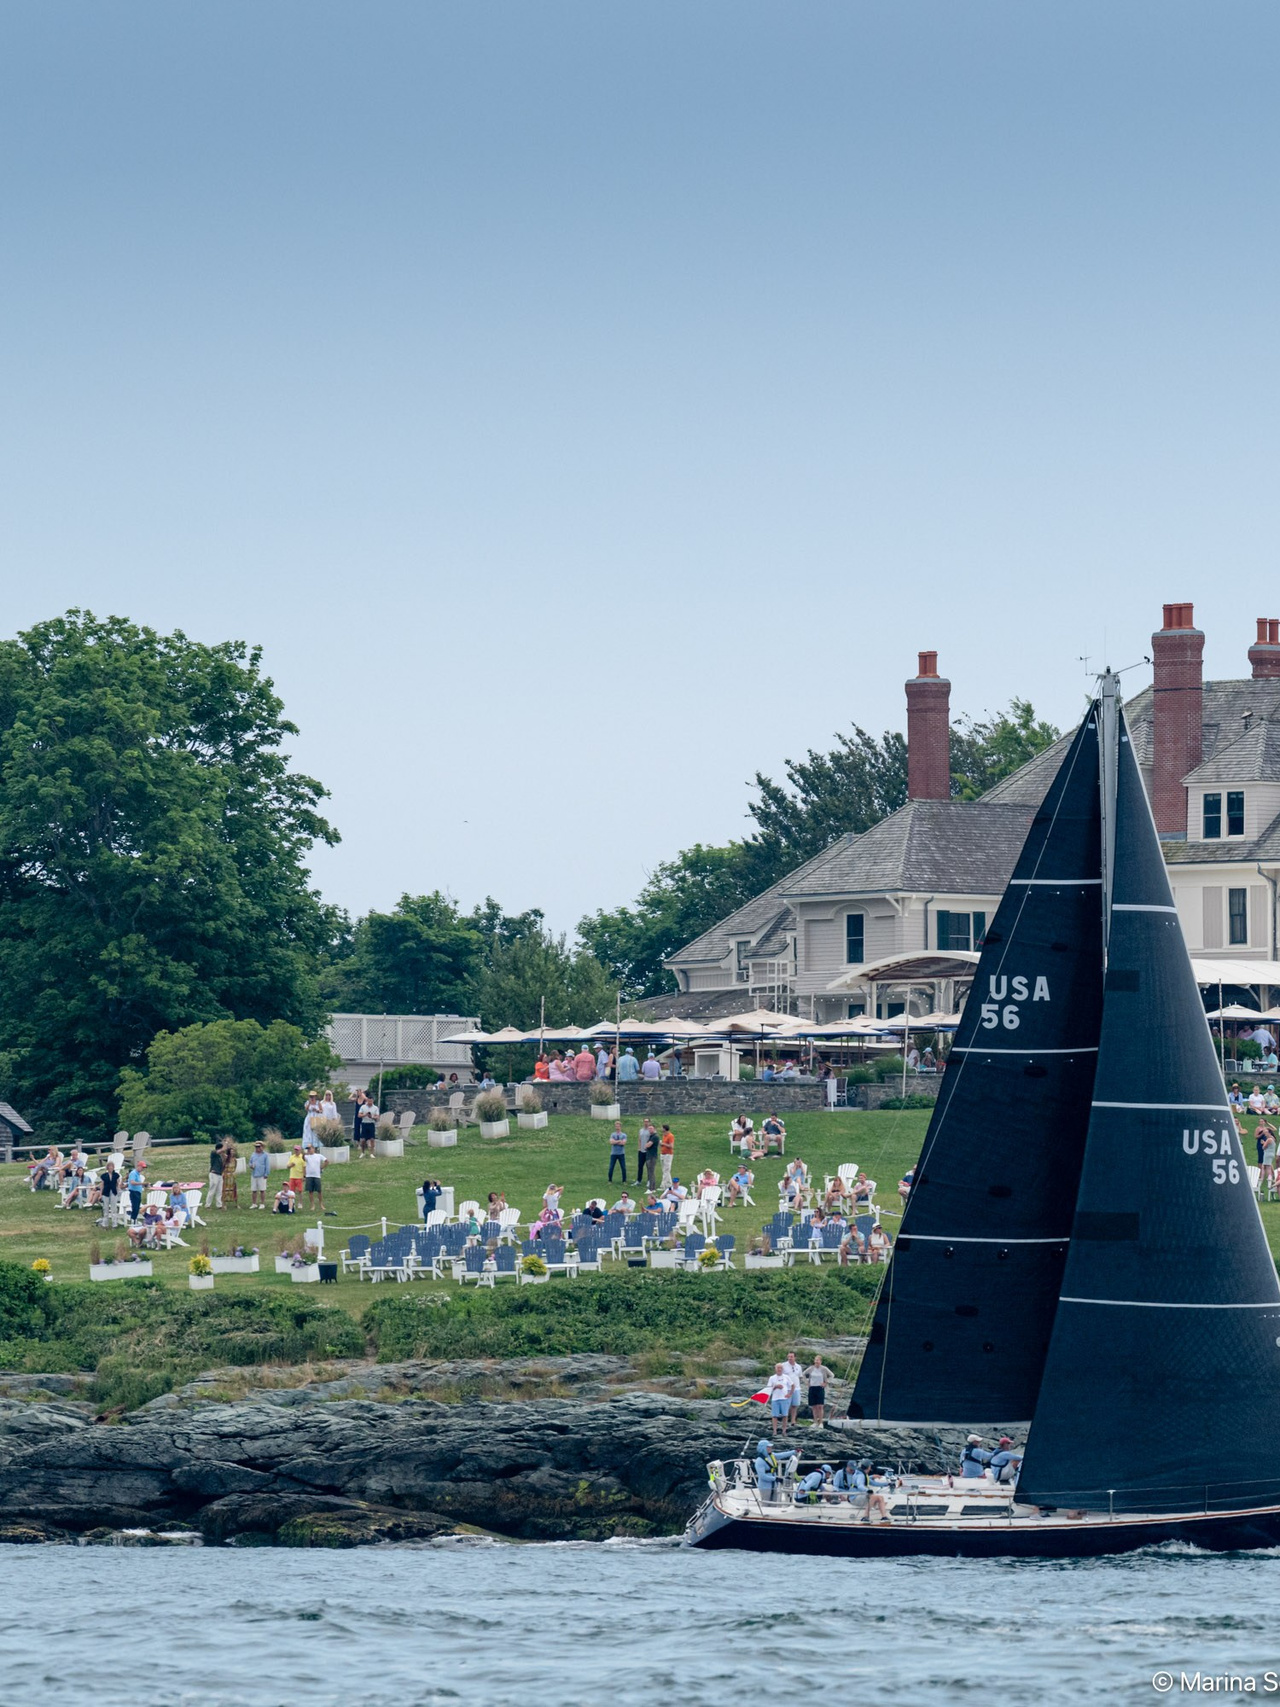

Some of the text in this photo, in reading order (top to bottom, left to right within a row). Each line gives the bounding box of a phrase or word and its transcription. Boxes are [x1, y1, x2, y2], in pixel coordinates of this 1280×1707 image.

[988, 975, 1051, 1001] USA
[981, 1004, 1020, 1030] 56
[1182, 1129, 1232, 1155] USA
[1212, 1159, 1240, 1185] 56
